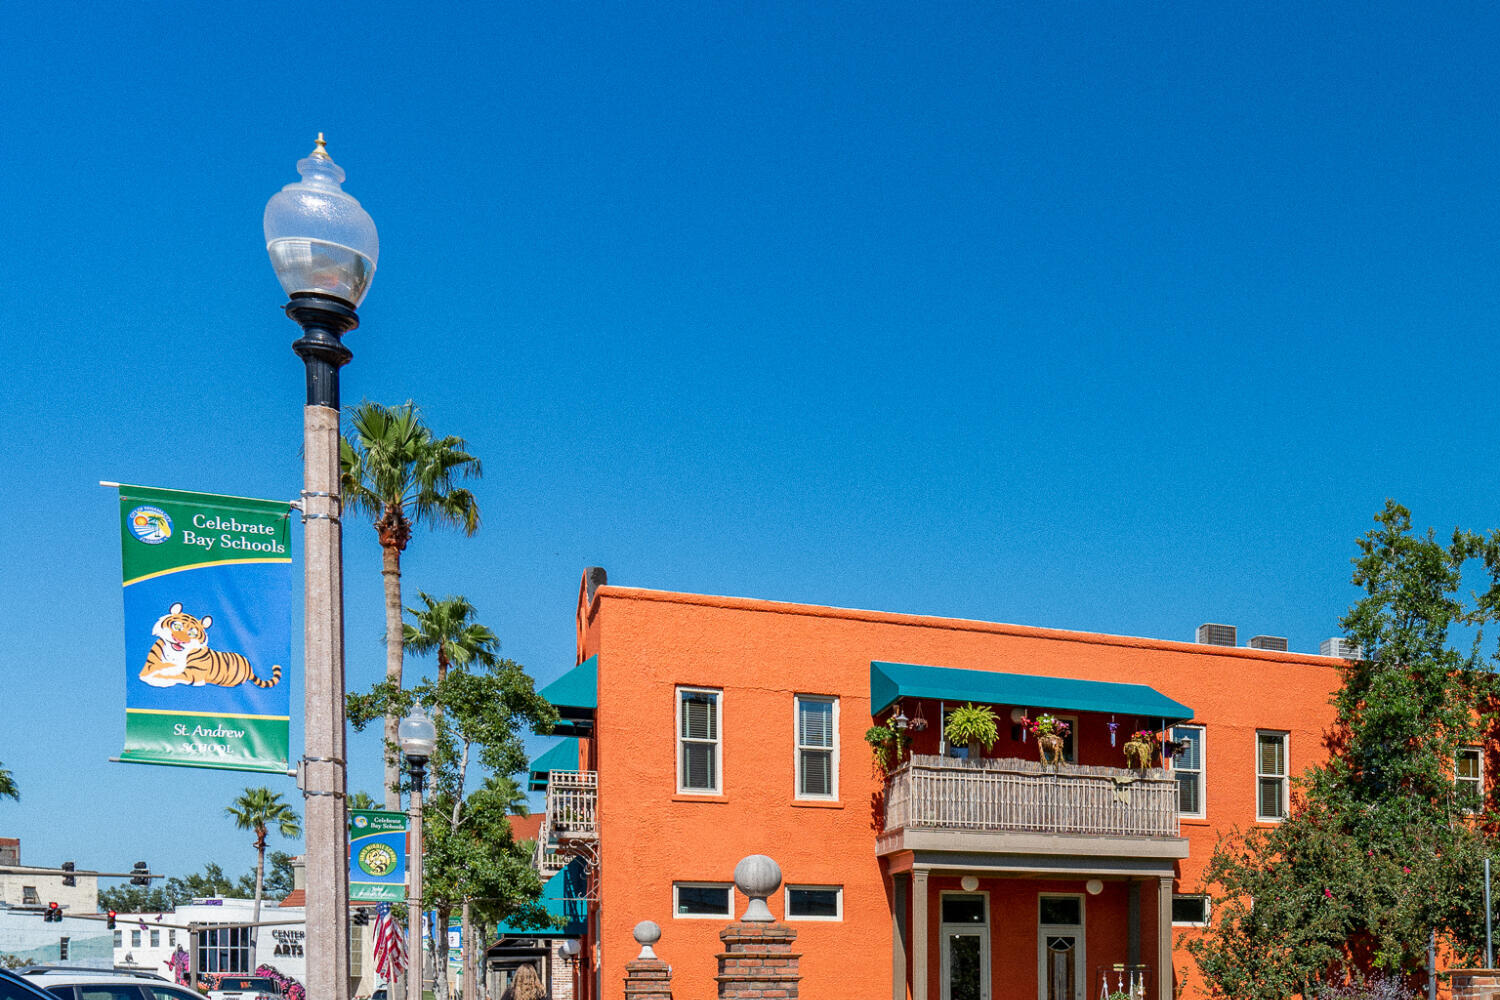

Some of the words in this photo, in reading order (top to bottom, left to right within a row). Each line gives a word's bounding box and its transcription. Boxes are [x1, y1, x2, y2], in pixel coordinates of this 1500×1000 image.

[192, 513, 275, 535] Celebrate
[183, 530, 215, 551] Bay
[220, 534, 285, 554] Schools
[192, 723, 245, 738] Andrew
[182, 742, 234, 754] SCHOOL
[271, 929, 305, 940] CENTER
[273, 943, 304, 956] ARTS
